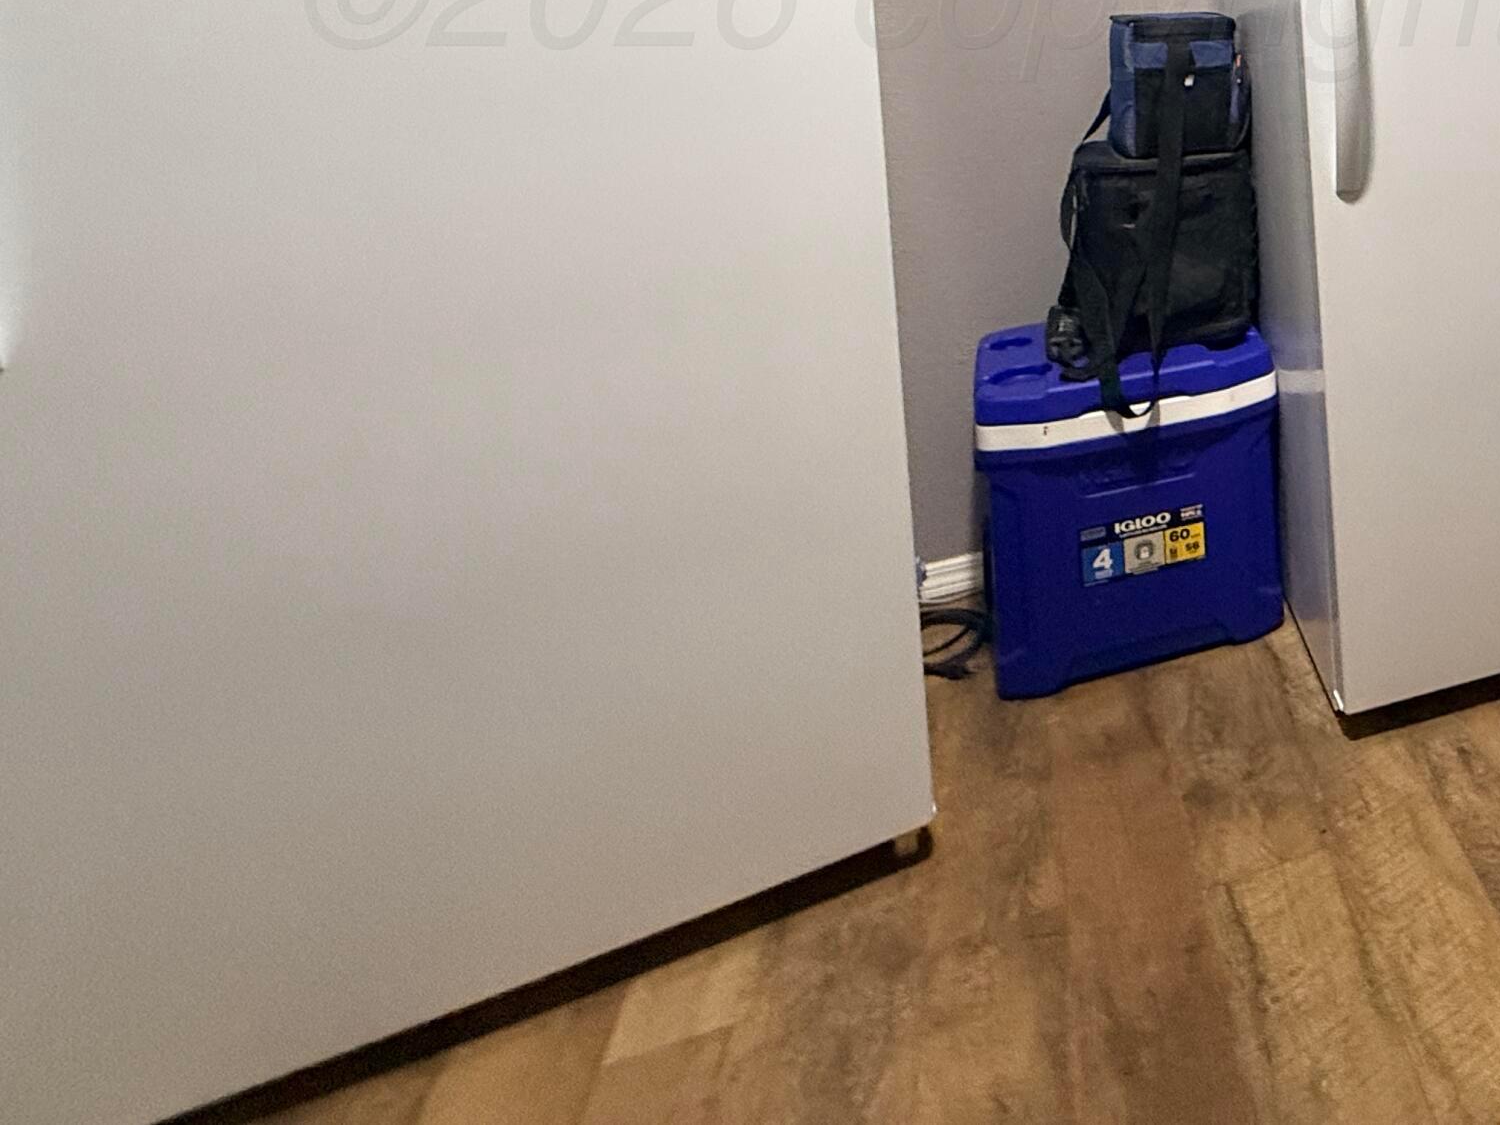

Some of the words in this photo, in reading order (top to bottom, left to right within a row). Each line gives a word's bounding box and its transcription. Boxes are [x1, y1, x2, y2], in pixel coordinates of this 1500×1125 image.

[1114, 511, 1171, 534] IGLOO
[1169, 528, 1190, 543] 60
[1093, 548, 1114, 569] 4
